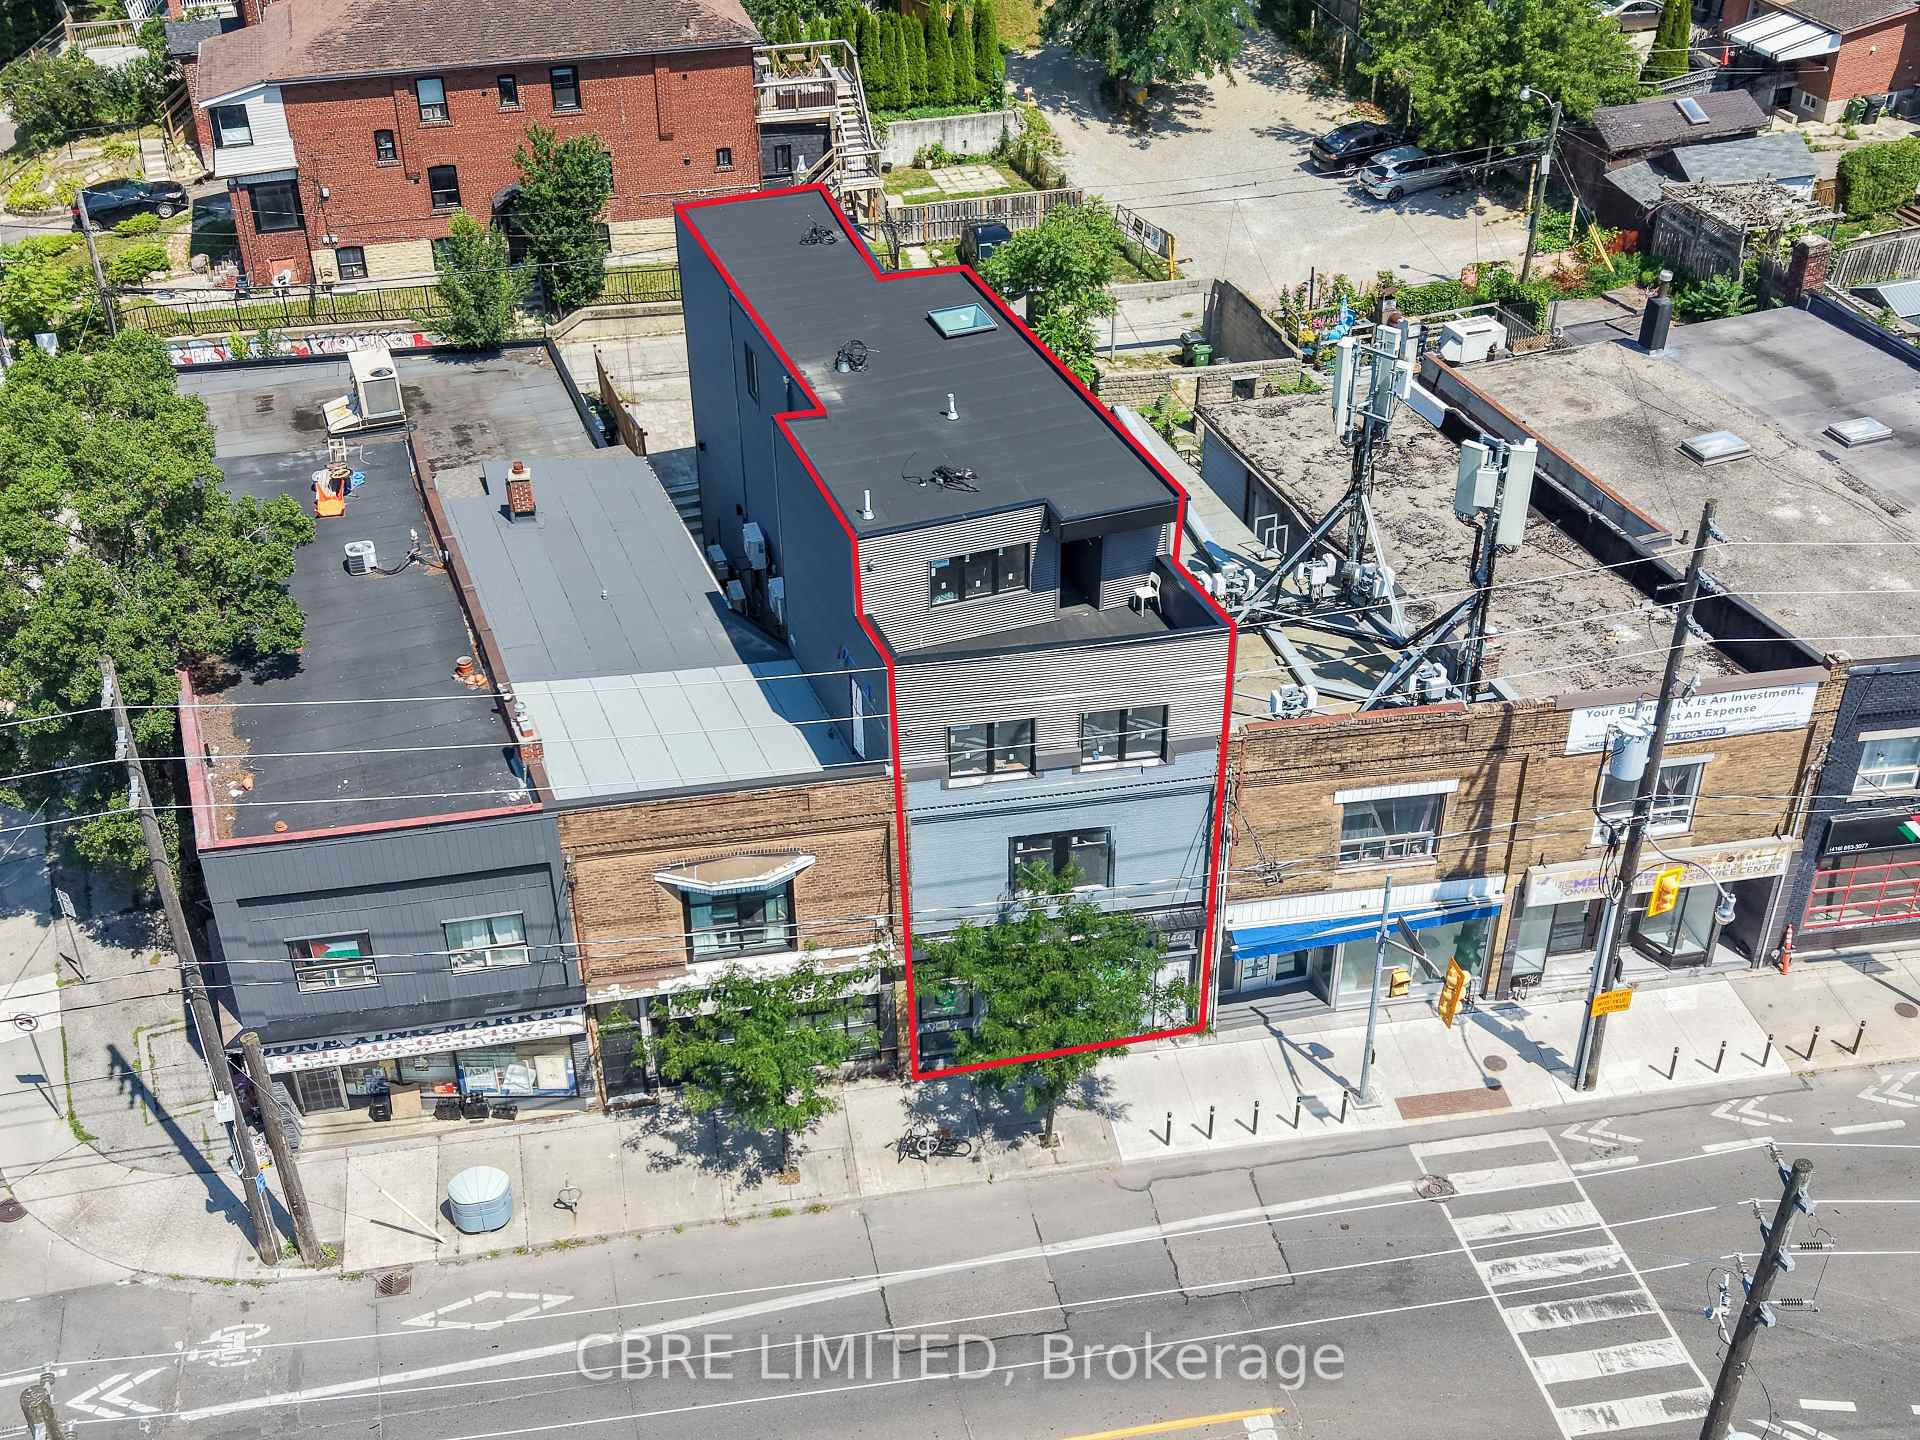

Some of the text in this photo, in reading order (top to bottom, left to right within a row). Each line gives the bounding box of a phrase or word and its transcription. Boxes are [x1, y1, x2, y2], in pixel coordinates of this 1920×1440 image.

[1586, 710, 1615, 719] Your
[1697, 698, 1706, 706] Is
[1710, 695, 1727, 705] An
[1731, 687, 1804, 703] Investment.
[1684, 710, 1701, 719] An
[1705, 705, 1757, 718] Expense
[441, 1007, 582, 1034] MARKET
